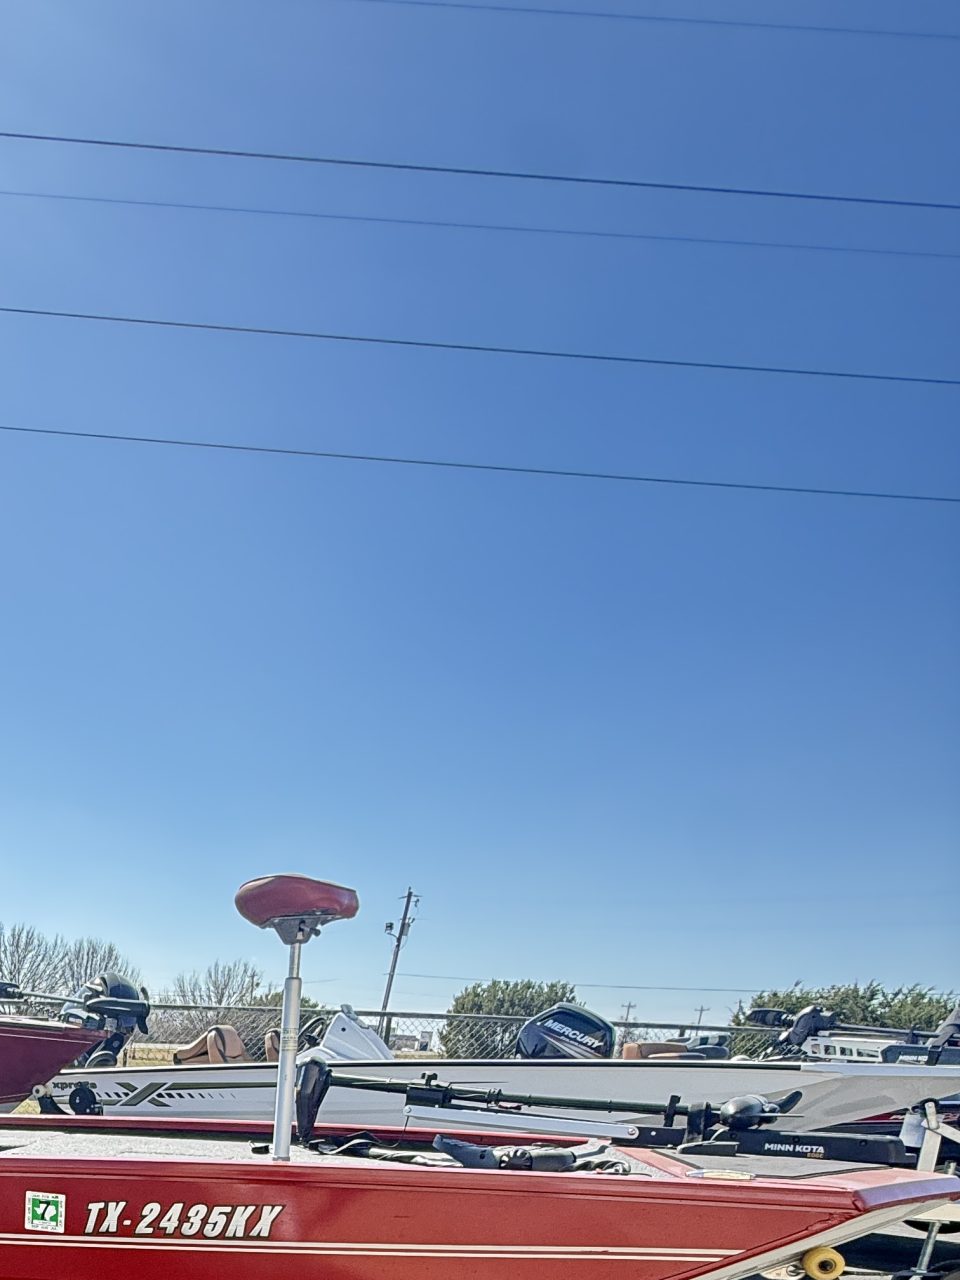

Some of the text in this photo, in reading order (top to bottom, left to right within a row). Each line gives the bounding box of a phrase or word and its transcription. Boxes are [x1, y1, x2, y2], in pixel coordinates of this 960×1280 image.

[544, 1020, 604, 1048] MERCURY
[764, 1143, 825, 1153] MINN KOTA
[38, 1200, 51, 1220] 7
[84, 1200, 285, 1238] TX-2435KX
